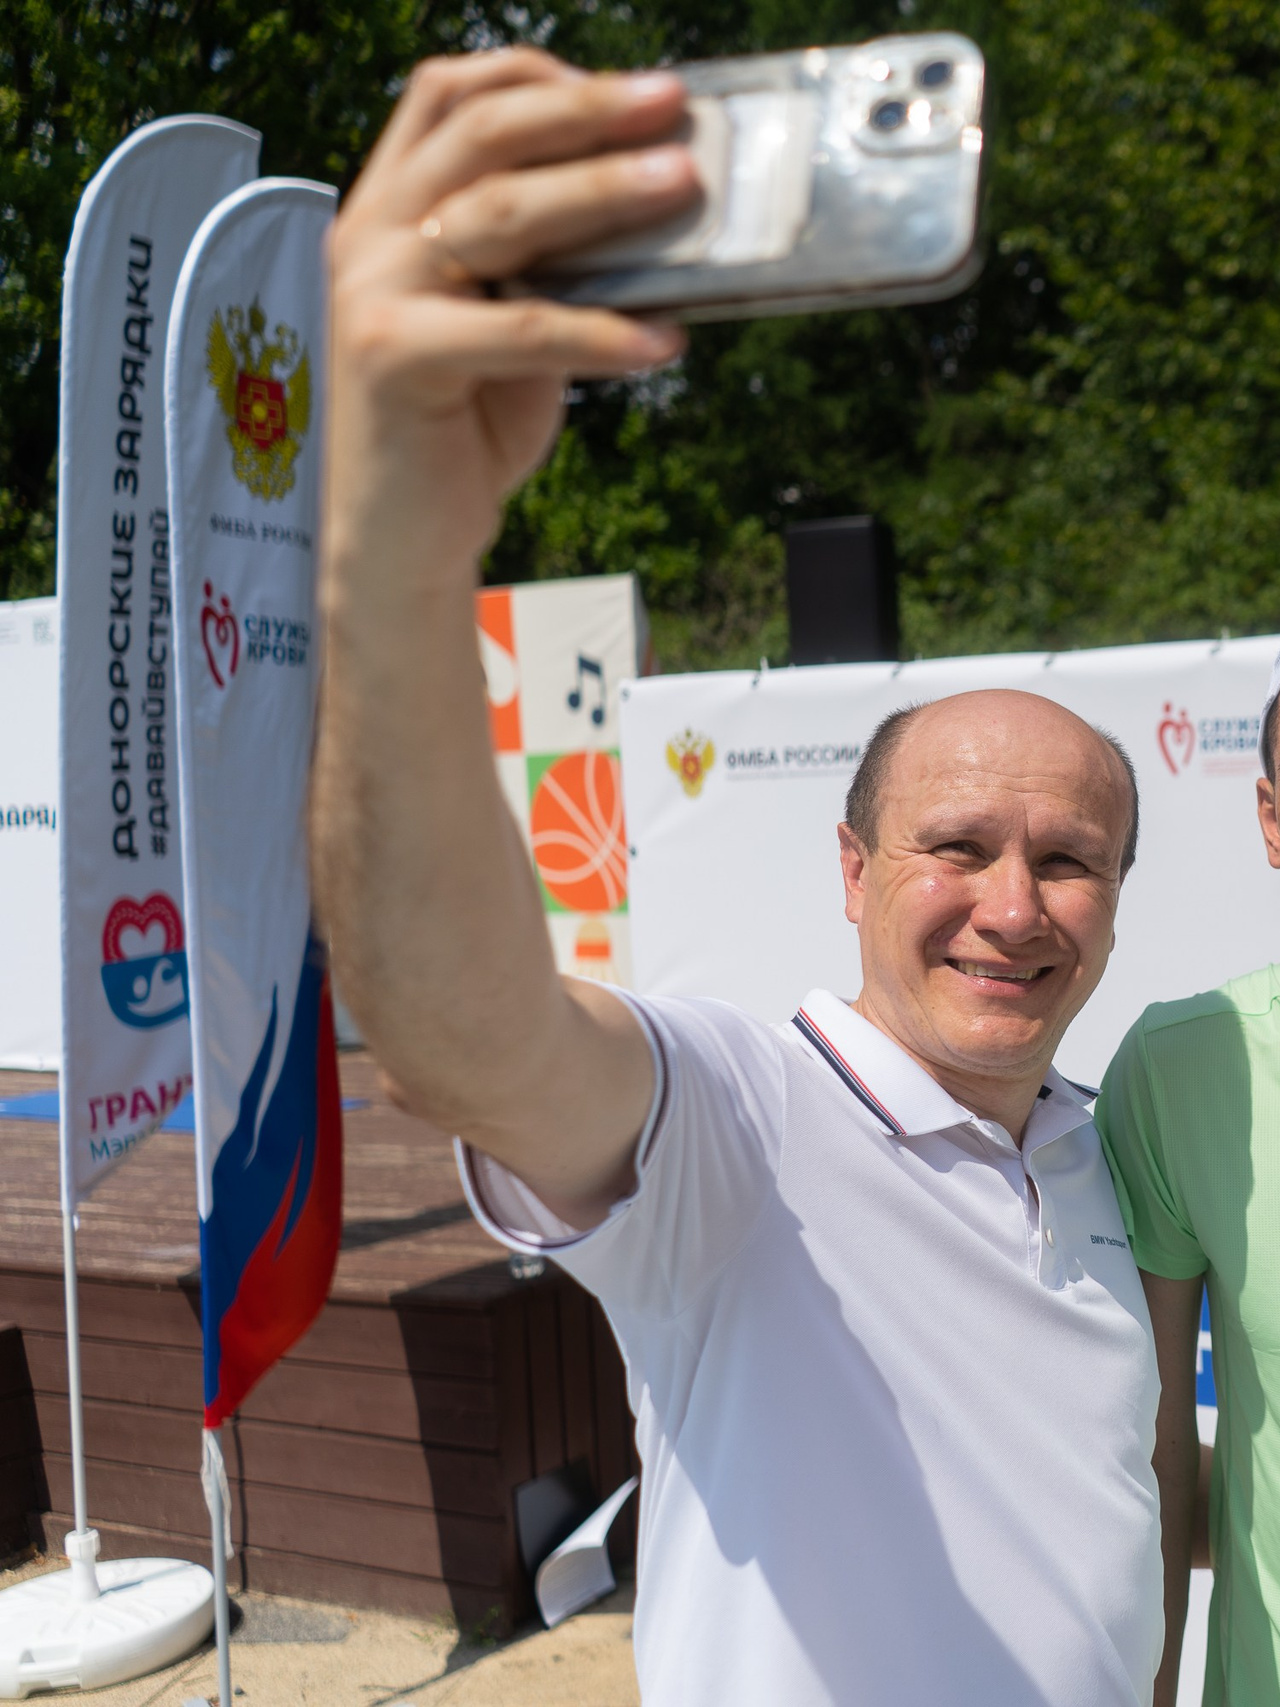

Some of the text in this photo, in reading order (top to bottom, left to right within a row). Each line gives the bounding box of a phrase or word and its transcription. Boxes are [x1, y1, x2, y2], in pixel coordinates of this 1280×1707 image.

[209, 513, 256, 541] ФМБА
[108, 233, 155, 863] ДОНОРСКИЕ ЗАРЯДКИ
[244, 612, 312, 646] СЛУЖБ
[725, 749, 780, 770] ФМБА
[1090, 1234, 1105, 1245] BMW
